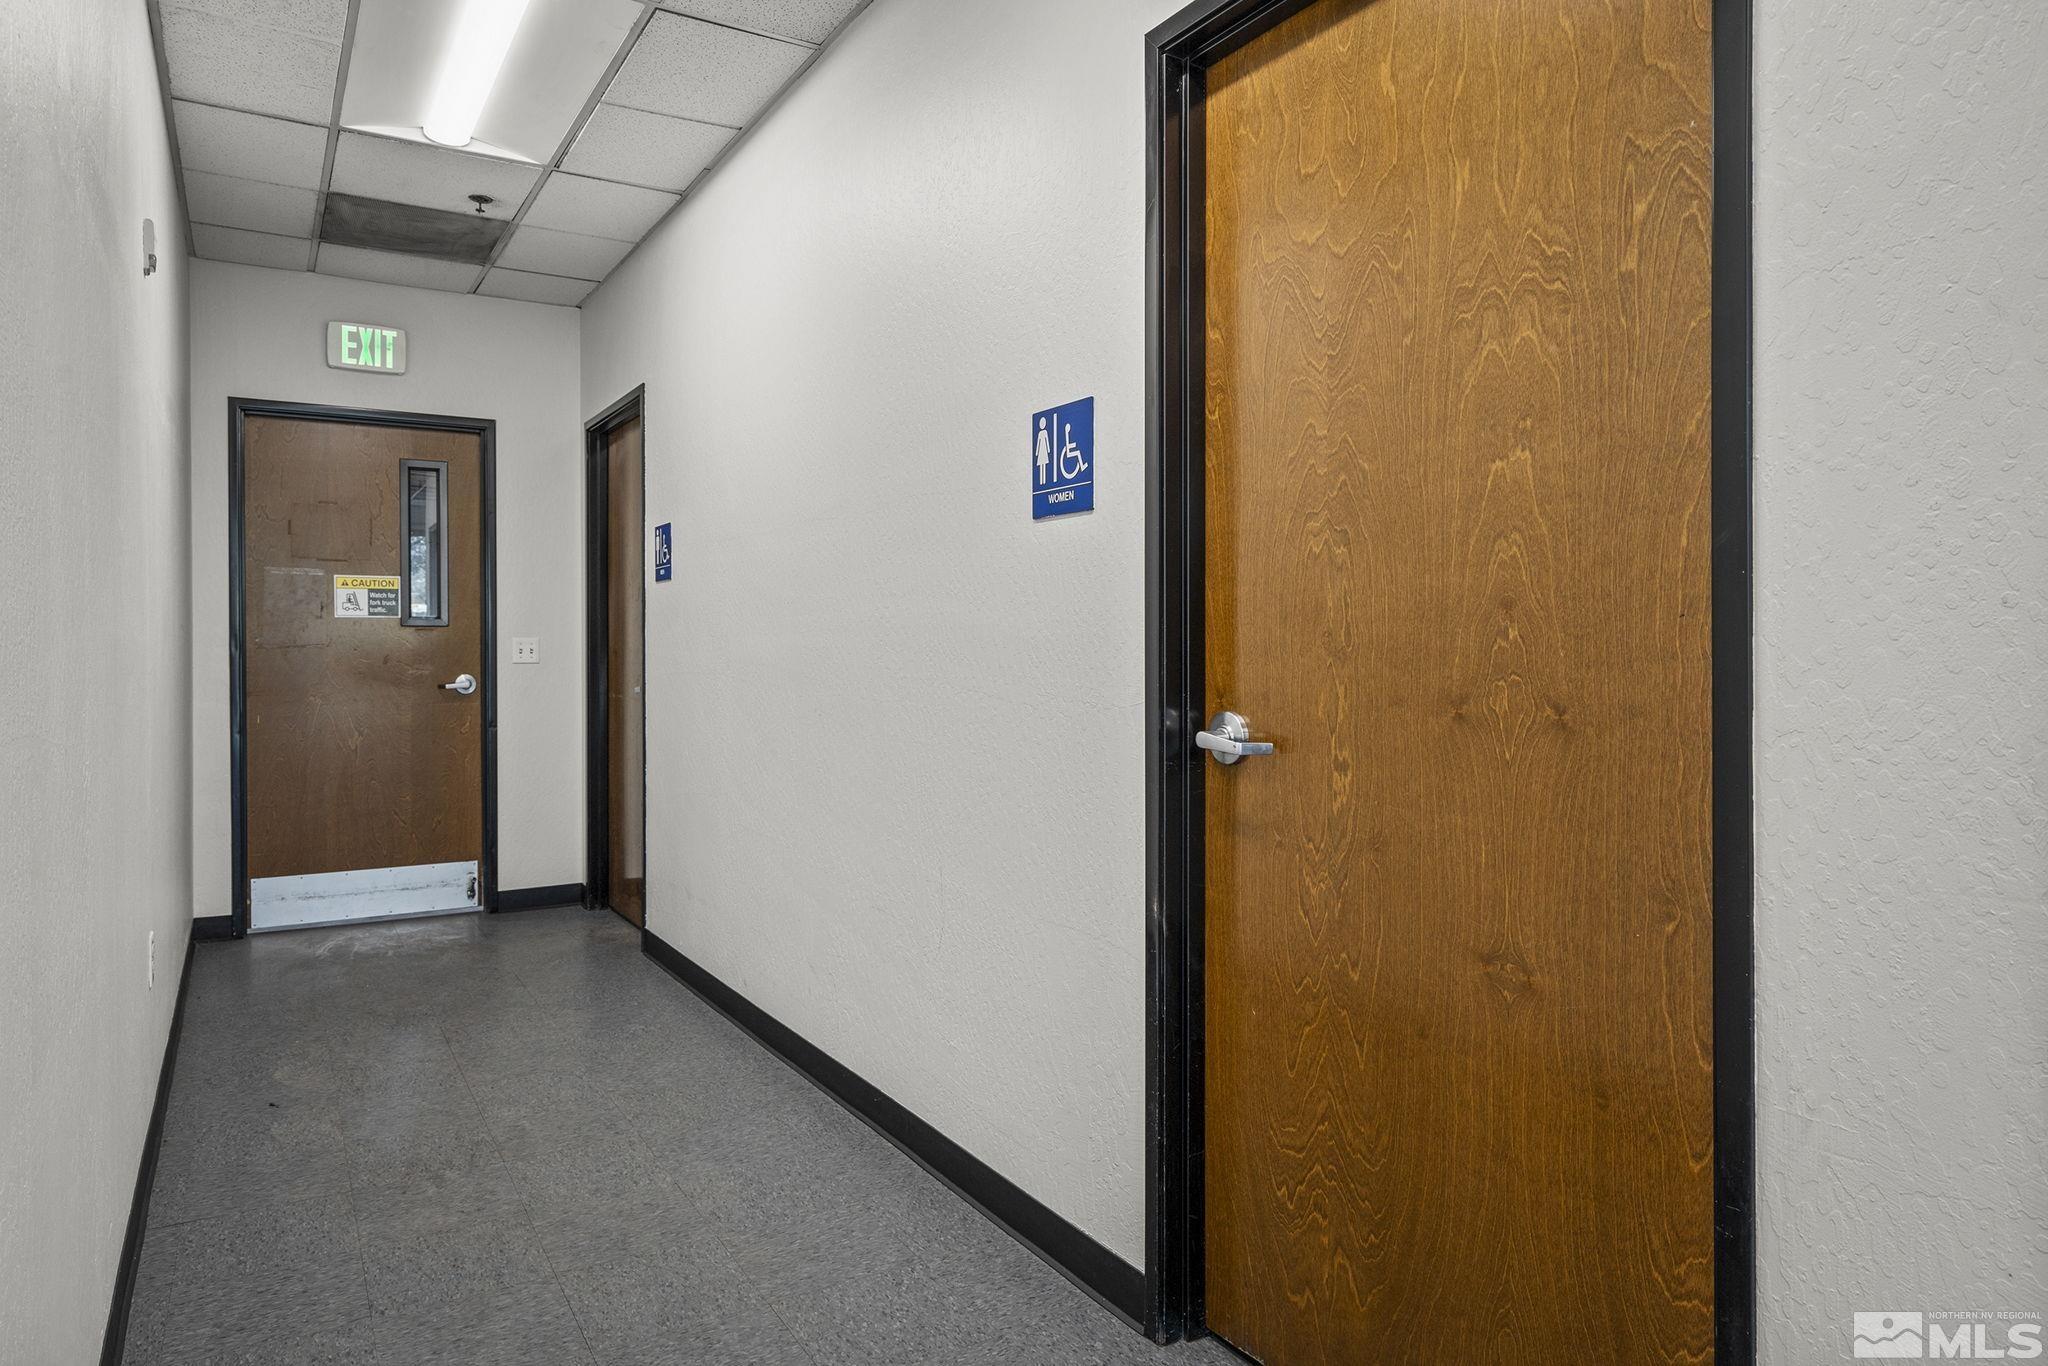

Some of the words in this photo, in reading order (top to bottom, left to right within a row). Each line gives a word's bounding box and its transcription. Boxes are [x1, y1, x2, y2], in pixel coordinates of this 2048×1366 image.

[341, 324, 398, 369] EXIT
[1048, 490, 1074, 504] WOMEN
[350, 579, 395, 587] CAUTION
